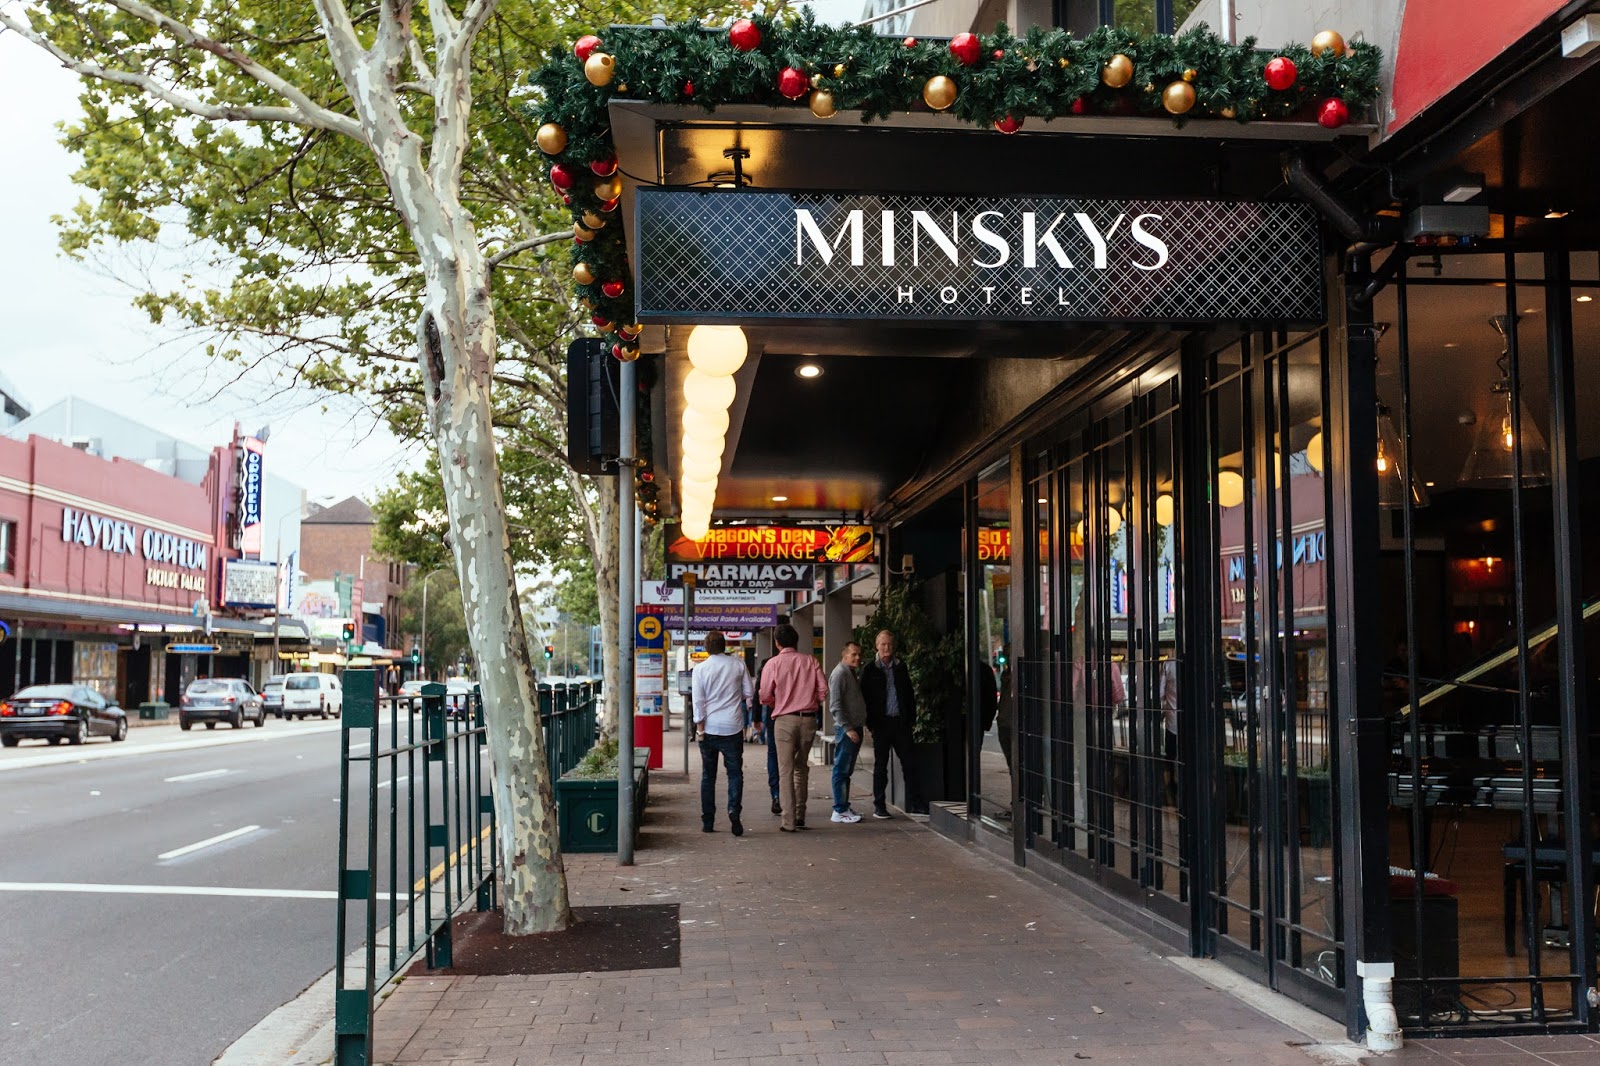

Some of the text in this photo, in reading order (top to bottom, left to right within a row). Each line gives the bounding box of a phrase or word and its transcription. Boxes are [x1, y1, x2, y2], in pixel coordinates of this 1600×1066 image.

[795, 207, 1170, 271] MINSKYS
[897, 286, 1071, 306] HOTEL
[246, 452, 260, 524] ORPHEUM
[62, 507, 207, 571] HAYDEN ORPHEUM
[695, 543, 816, 560] VIP LOUNGE
[147, 567, 179, 589] PICTURE
[180, 573, 206, 593] PALACE
[671, 564, 809, 580] PHARMACY
[693, 615, 719, 623] Special
[739, 615, 772, 623] Available
[695, 606, 723, 614] RVICED
[725, 606, 772, 614] APARTMENTS
